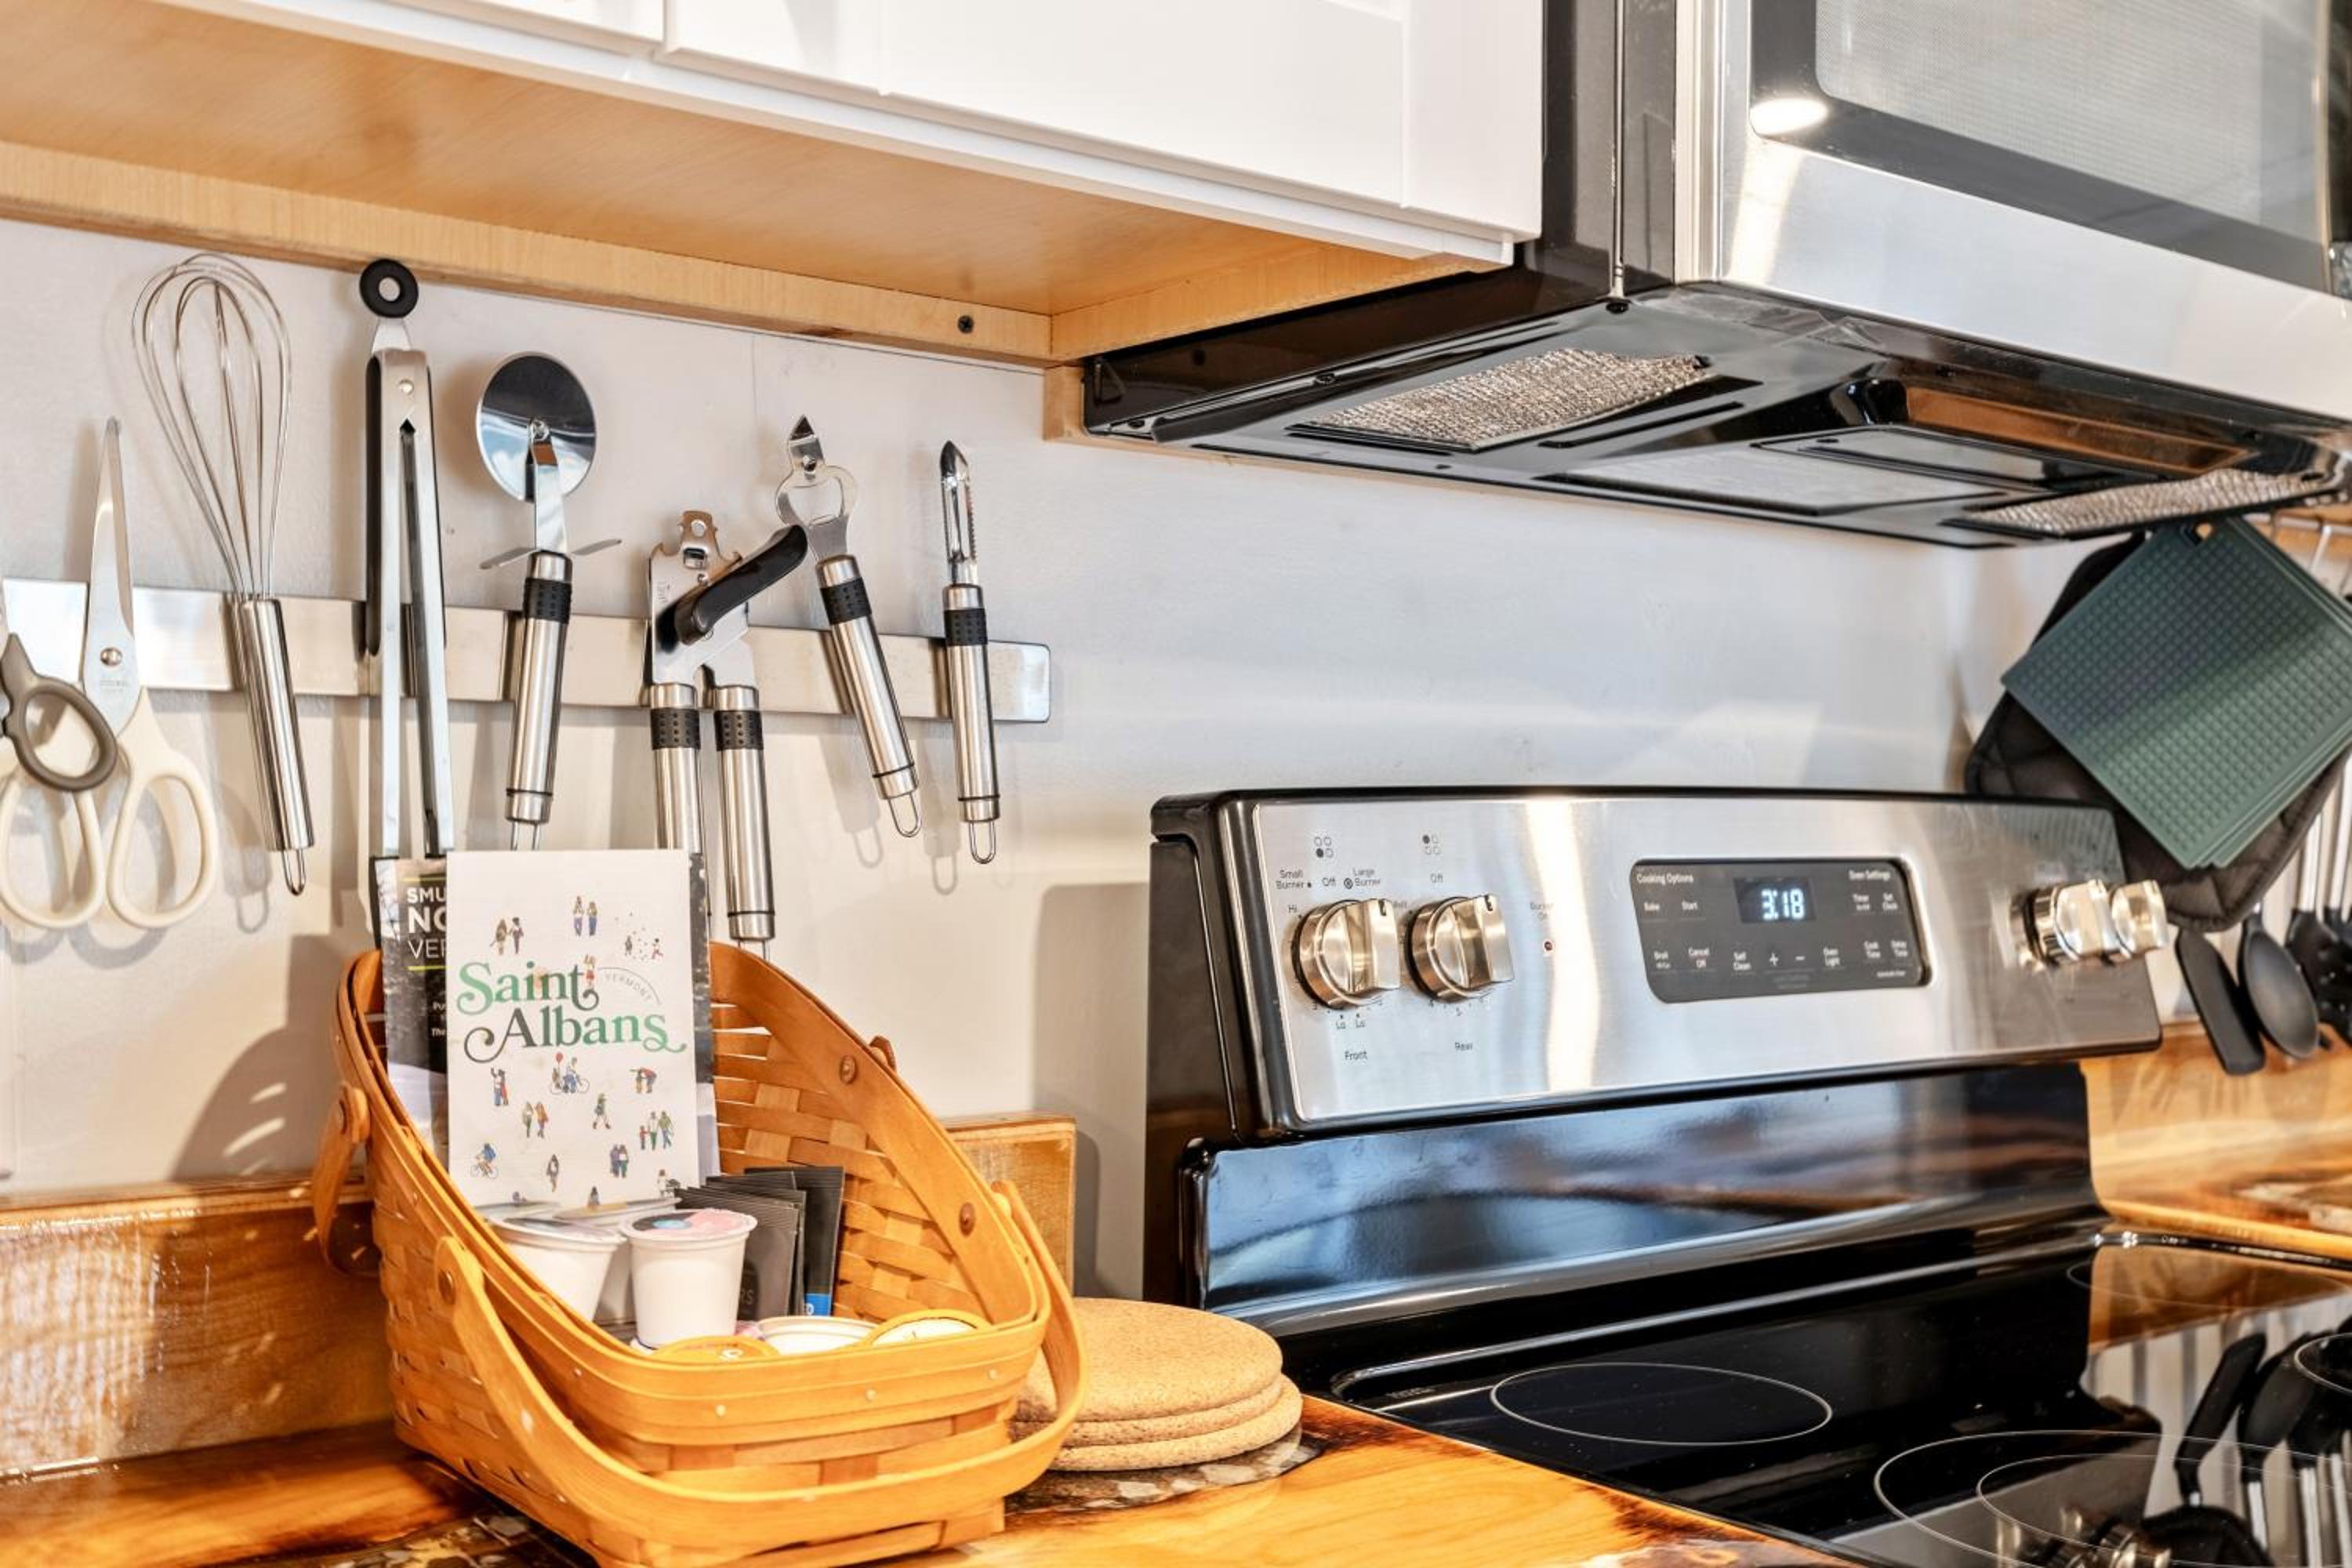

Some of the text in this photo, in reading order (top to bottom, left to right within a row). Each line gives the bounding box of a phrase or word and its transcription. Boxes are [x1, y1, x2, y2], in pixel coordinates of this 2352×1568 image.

[1279, 869, 1303, 879] Small
[1276, 880, 1305, 890] Burner
[1322, 877, 1337, 887] Off
[1761, 888, 1805, 920] 3:18
[456, 961, 599, 1015] Saint
[464, 1004, 687, 1063] Albans
[1345, 1050, 1368, 1061] Front
